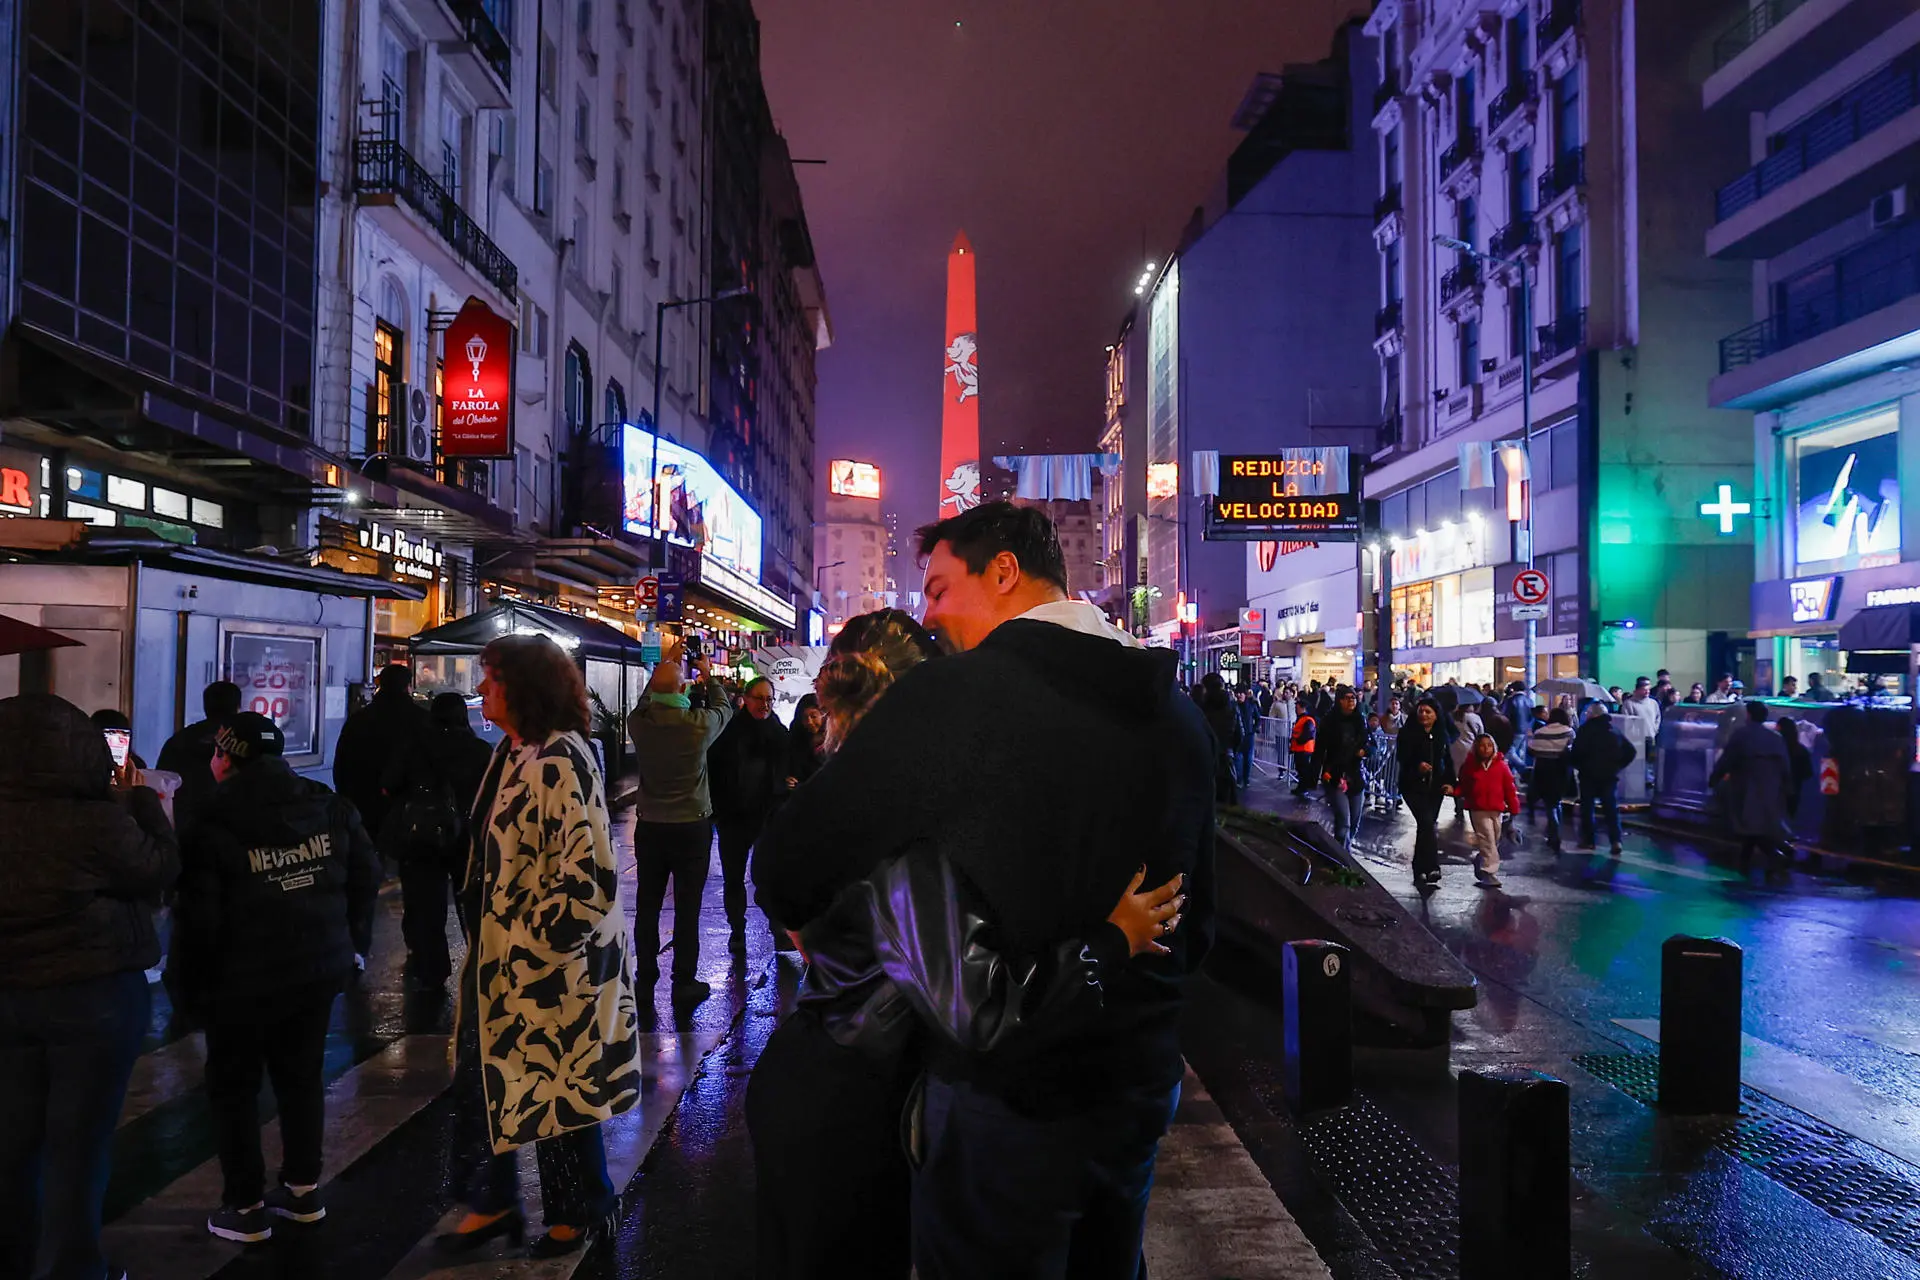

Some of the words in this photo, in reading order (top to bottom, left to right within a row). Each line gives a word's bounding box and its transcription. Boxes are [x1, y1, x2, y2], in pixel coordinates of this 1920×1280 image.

[468, 388, 485, 398] LA
[452, 401, 500, 410] FAROLA
[1232, 460, 1325, 476] REDUZCA
[1272, 481, 1299, 497] LA
[1219, 502, 1340, 519] VELOCIDAD
[371, 522, 391, 554] La
[393, 529, 434, 566] Farola
[394, 559, 406, 574] del
